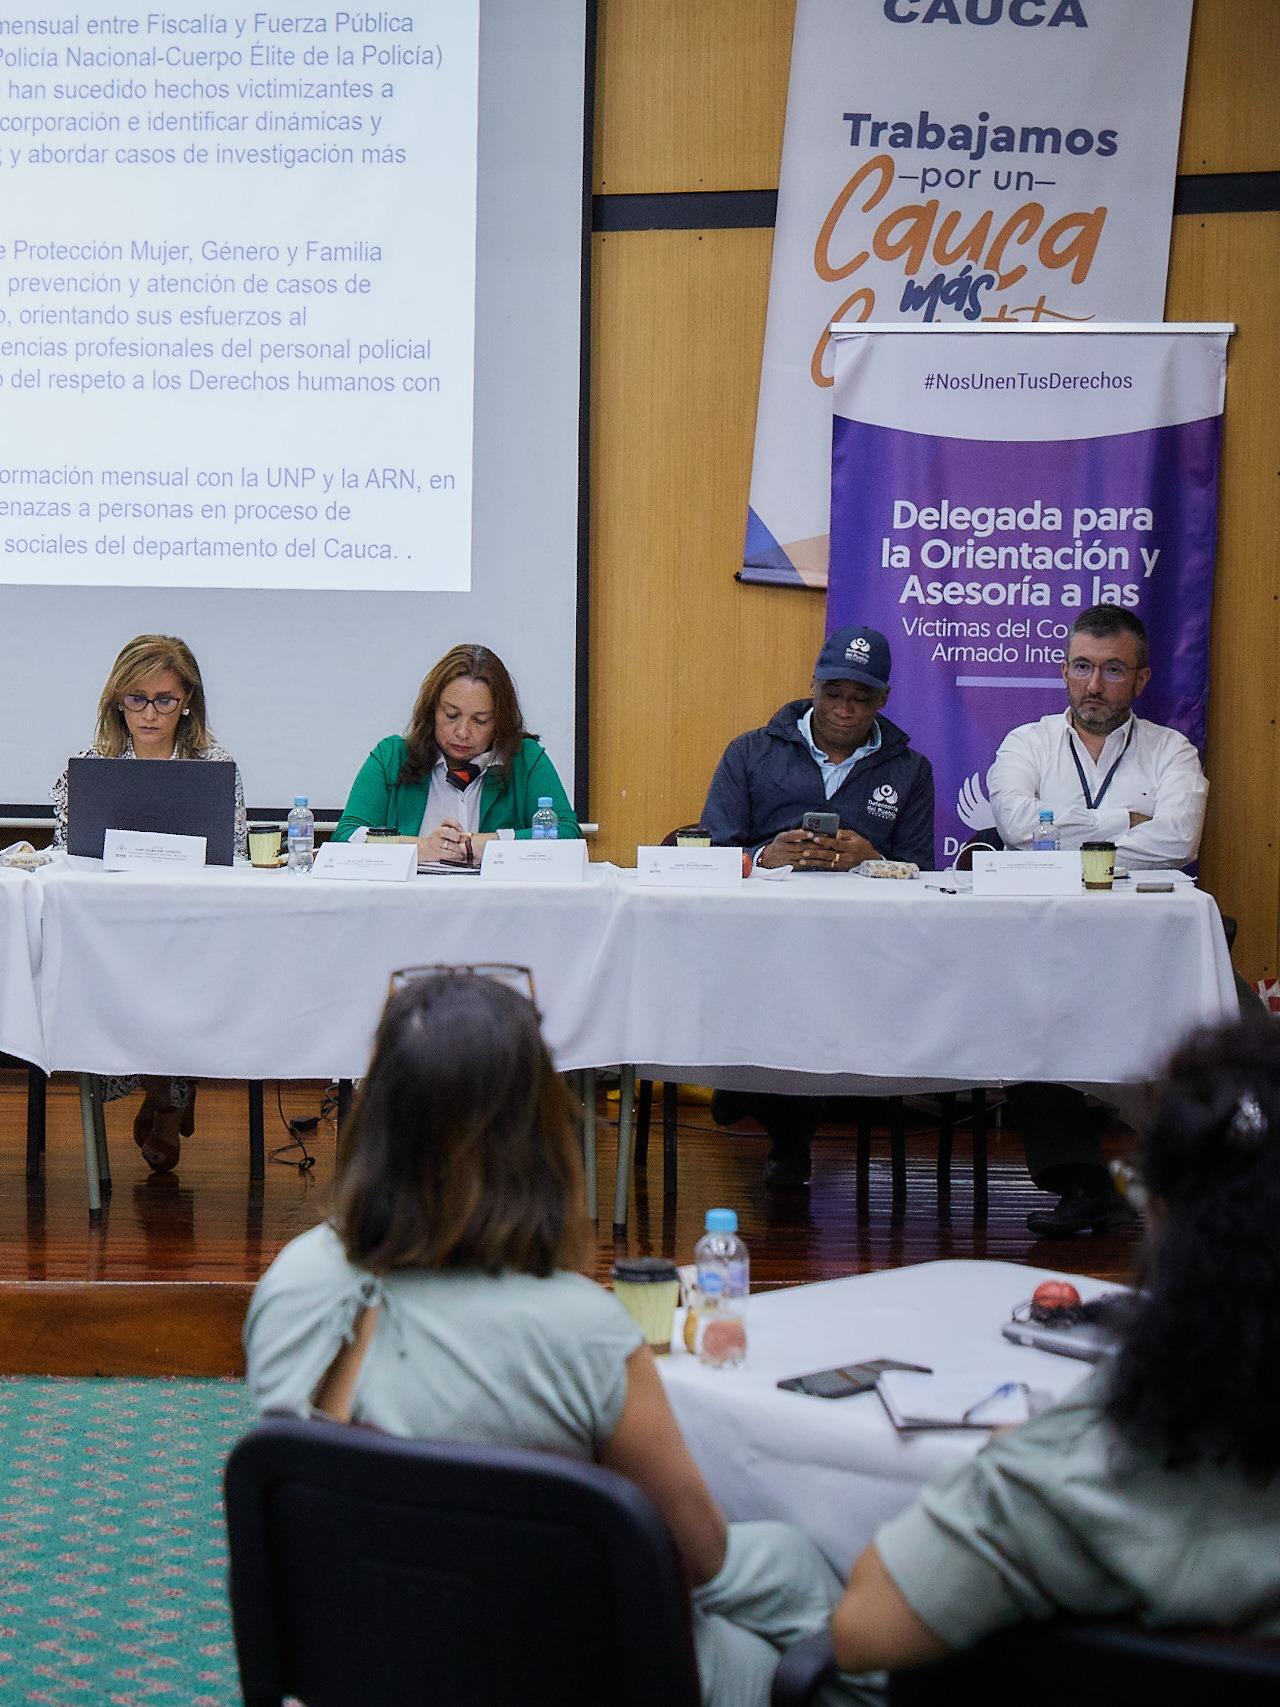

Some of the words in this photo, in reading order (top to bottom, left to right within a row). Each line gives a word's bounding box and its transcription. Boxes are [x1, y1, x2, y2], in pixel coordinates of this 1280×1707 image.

[87, 16, 139, 34] entre
[147, 13, 227, 34] Fiscalía
[235, 18, 246, 39] y
[254, 13, 327, 33] Fuerza
[336, 12, 413, 33] Pública
[884, 0, 1089, 27] CAUCA
[66, 46, 242, 71] Nacional-Cuerpo
[251, 41, 295, 66] Élite
[303, 45, 329, 66] de
[337, 45, 354, 66] la
[362, 44, 442, 70] Policía)
[843, 111, 1119, 160] Trabajamos
[814, 154, 1108, 291] Cauca
[14, 240, 123, 260] Protección
[131, 240, 192, 266] Mujer,
[201, 240, 280, 261] Género
[286, 246, 298, 267] y
[306, 240, 382, 262] Familia
[8, 272, 121, 297] prevención
[129, 278, 140, 298] y
[147, 273, 235, 293] atención
[243, 273, 268, 293] de
[276, 278, 338, 294] casos
[345, 273, 371, 294] de
[899, 264, 995, 322] más
[924, 371, 1133, 390] #NosUnenTusDerechos
[102, 467, 188, 486] mensual
[197, 472, 233, 487] con
[241, 467, 258, 487] la
[267, 467, 316, 488] UNP
[323, 473, 334, 493] y
[342, 468, 359, 489] la
[365, 468, 421, 493] ARN,
[429, 474, 455, 490] en
[893, 500, 1063, 538] Delegada
[1073, 506, 1153, 538] para
[881, 537, 910, 568] la
[920, 538, 1129, 570] Orientación
[1140, 548, 1161, 578] y
[899, 574, 1051, 606] Asesoría
[1060, 583, 1081, 606] a
[1092, 576, 1140, 606] las
[902, 617, 991, 638] Víctimas
[996, 618, 1031, 638] del
[931, 643, 1018, 663] Armado
[1025, 644, 1065, 663] Inte
